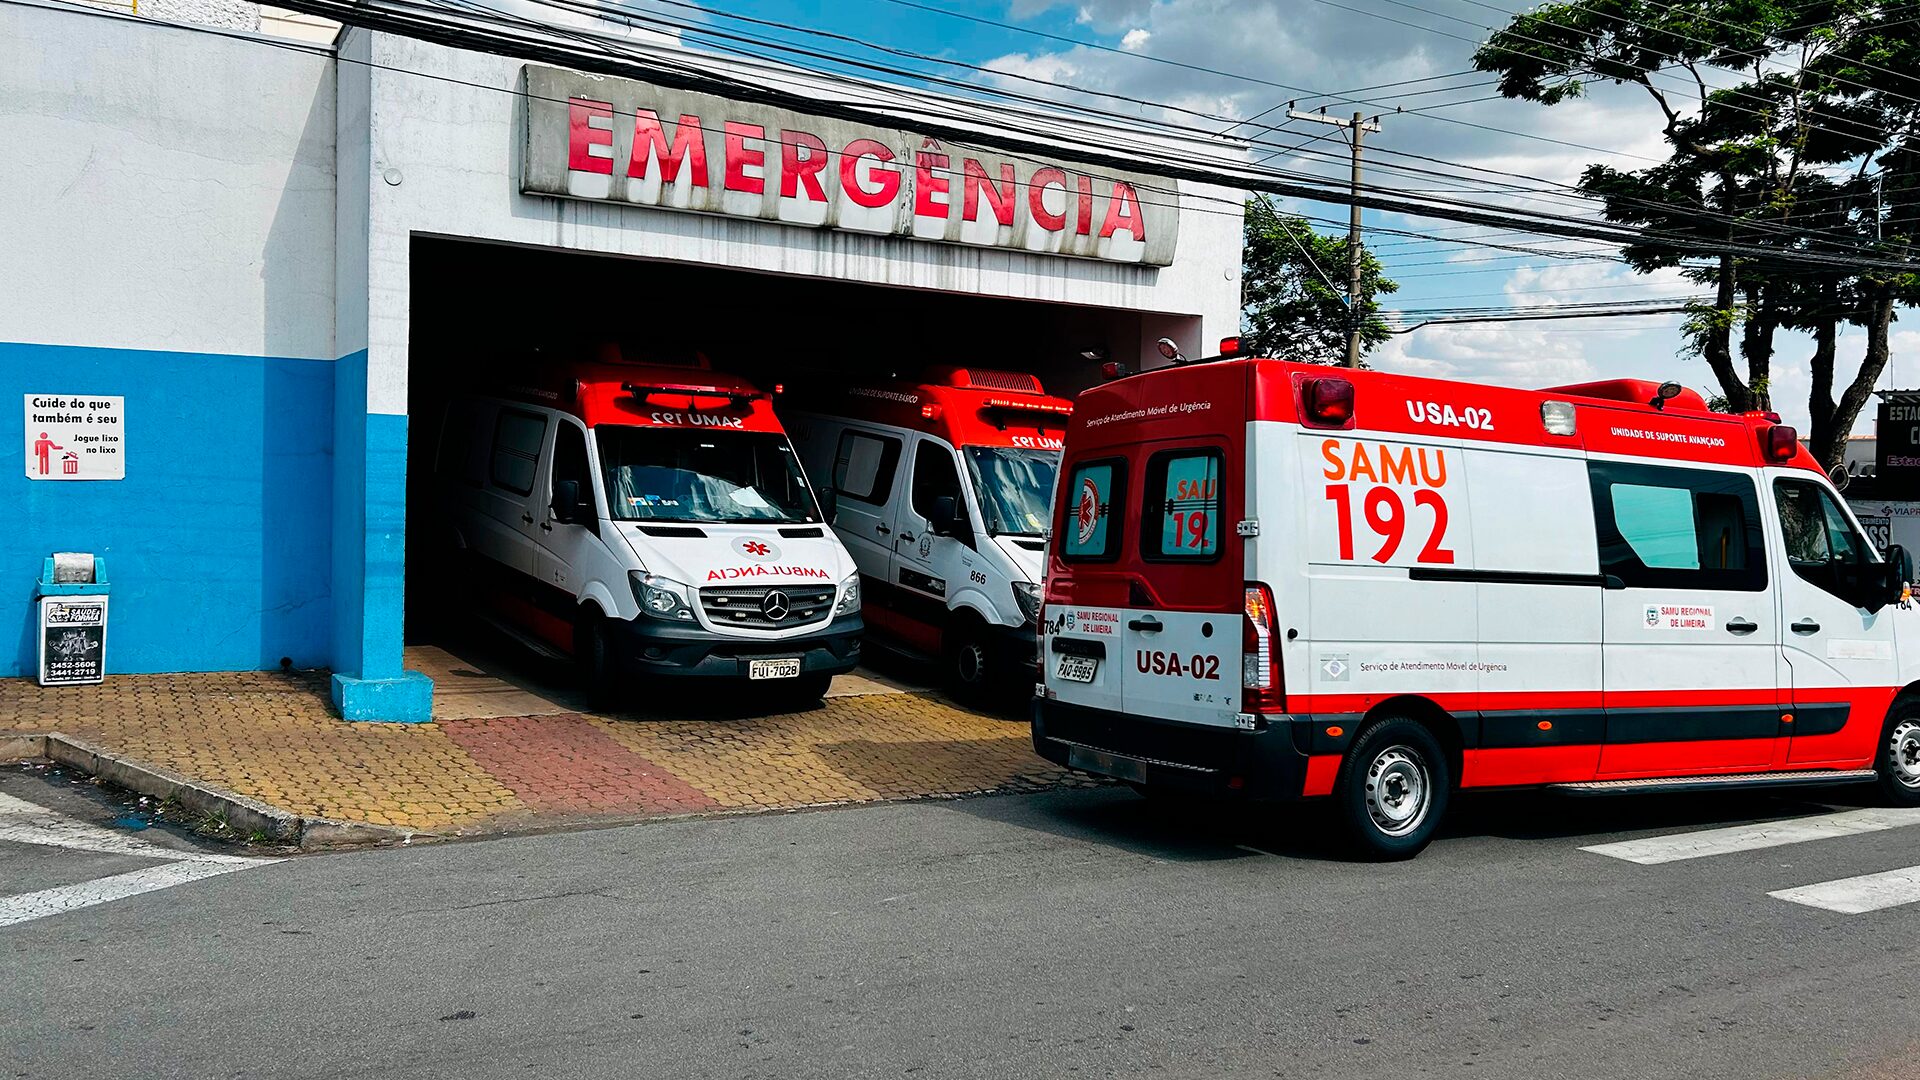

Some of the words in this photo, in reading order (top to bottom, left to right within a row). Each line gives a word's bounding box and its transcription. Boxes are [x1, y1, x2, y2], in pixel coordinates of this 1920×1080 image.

[568, 96, 1147, 242] EMERGÊNCIA
[32, 397, 66, 408] Cuide
[70, 398, 85, 409] do
[89, 401, 111, 411] que
[1110, 410, 1145, 421] Atendimento
[1147, 406, 1167, 416] Móvel
[1169, 404, 1178, 413] de
[1180, 400, 1211, 413] Urgência
[32, 413, 82, 423] também
[86, 413, 93, 423] é
[97, 416, 117, 424] seu
[1406, 400, 1494, 430] USA-02
[74, 434, 99, 443] Jogue
[102, 434, 118, 442] lixo
[1611, 427, 1644, 439] UNIDADE
[1645, 431, 1655, 440] DE
[1656, 432, 1687, 443] SUPORTE
[1689, 435, 1725, 448] AVANÇADO
[1911, 426, 1920, 445] C
[1321, 439, 1447, 488] SAMU
[1325, 484, 1454, 564] 192
[970, 570, 986, 585] 866
[1076, 611, 1091, 620] SAMU
[1092, 612, 1119, 622] REGIONAL
[1661, 607, 1679, 615] SAMU
[1681, 607, 1712, 616] REGIONAL
[1045, 620, 1061, 635] 784
[1083, 623, 1090, 632] DE
[1091, 624, 1112, 634] LIMEIRA
[1670, 619, 1679, 627] DE
[1680, 619, 1706, 628] LIMEIRA
[51, 661, 96, 669] 3452-5606
[51, 668, 95, 676] 3441-2719
[1137, 650, 1220, 680] USA-02
[1360, 662, 1388, 672] Serviço
[1389, 661, 1399, 671] de
[1400, 661, 1445, 670] Atendimento
[1469, 661, 1477, 671] de
